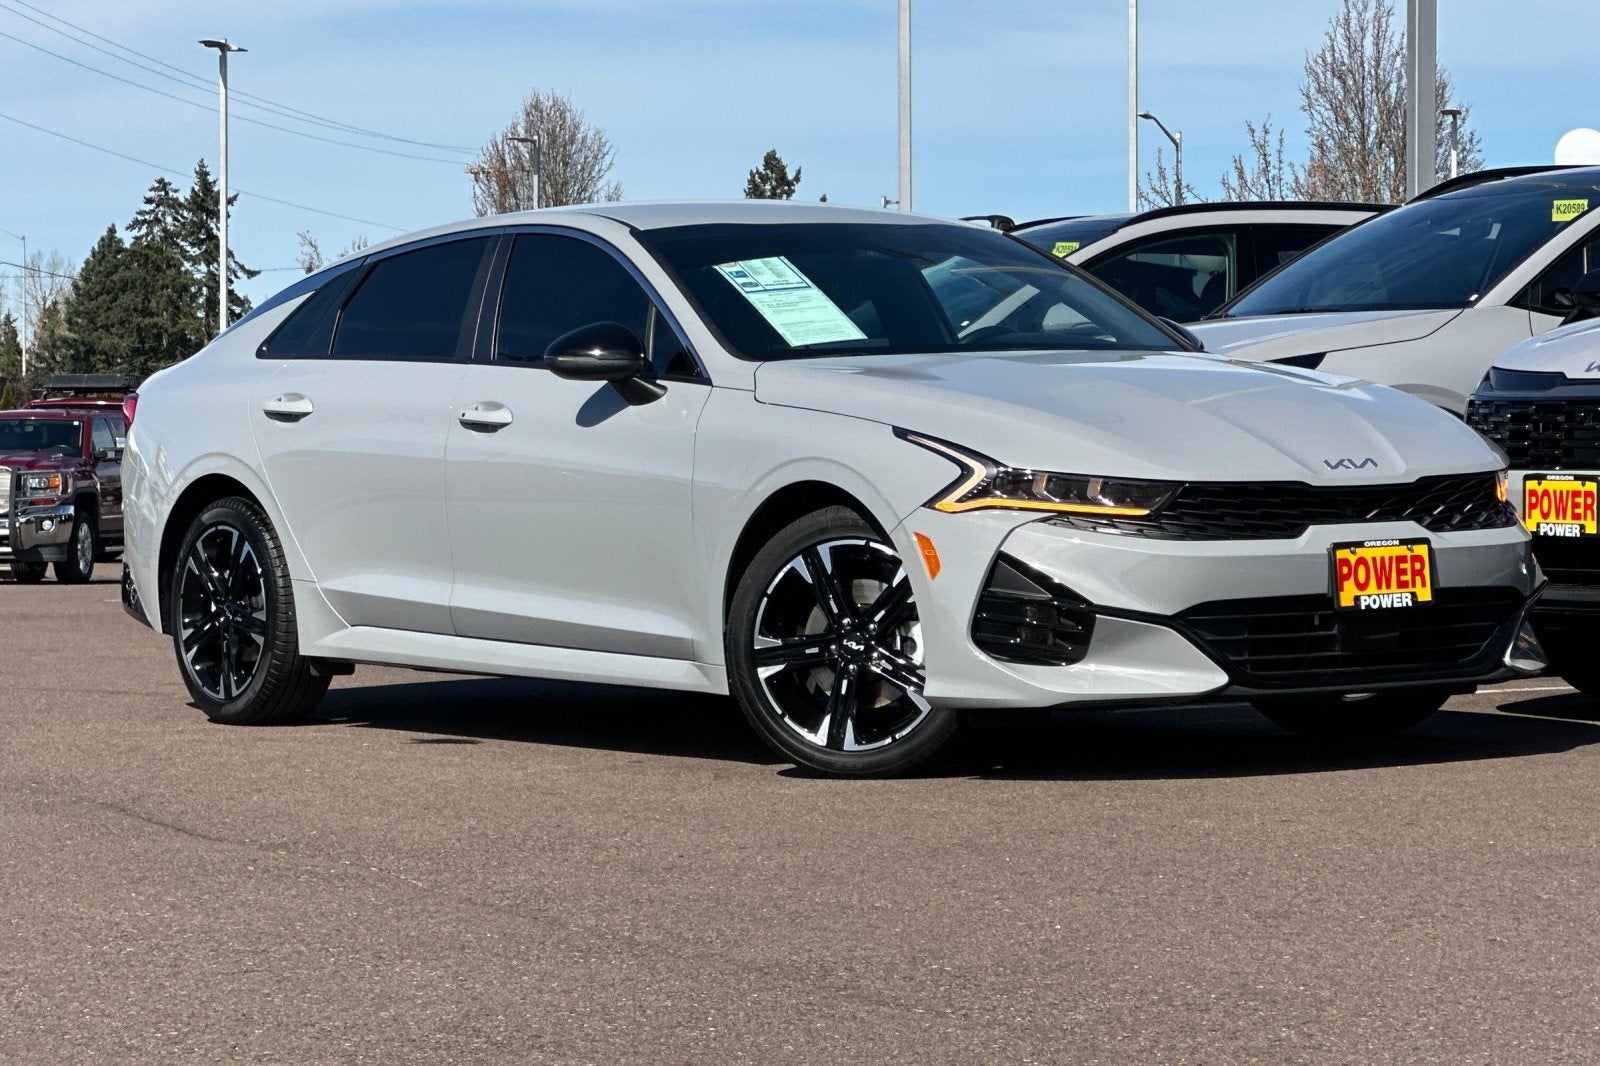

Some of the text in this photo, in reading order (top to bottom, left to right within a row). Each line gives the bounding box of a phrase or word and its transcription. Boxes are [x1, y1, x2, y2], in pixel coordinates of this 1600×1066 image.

[1556, 203, 1585, 214] K20589
[1323, 457, 1378, 470] KIA
[1527, 488, 1596, 521] POWER
[1540, 523, 1580, 537] POWER
[1337, 554, 1427, 592] POWER
[1360, 592, 1413, 610] POWER
